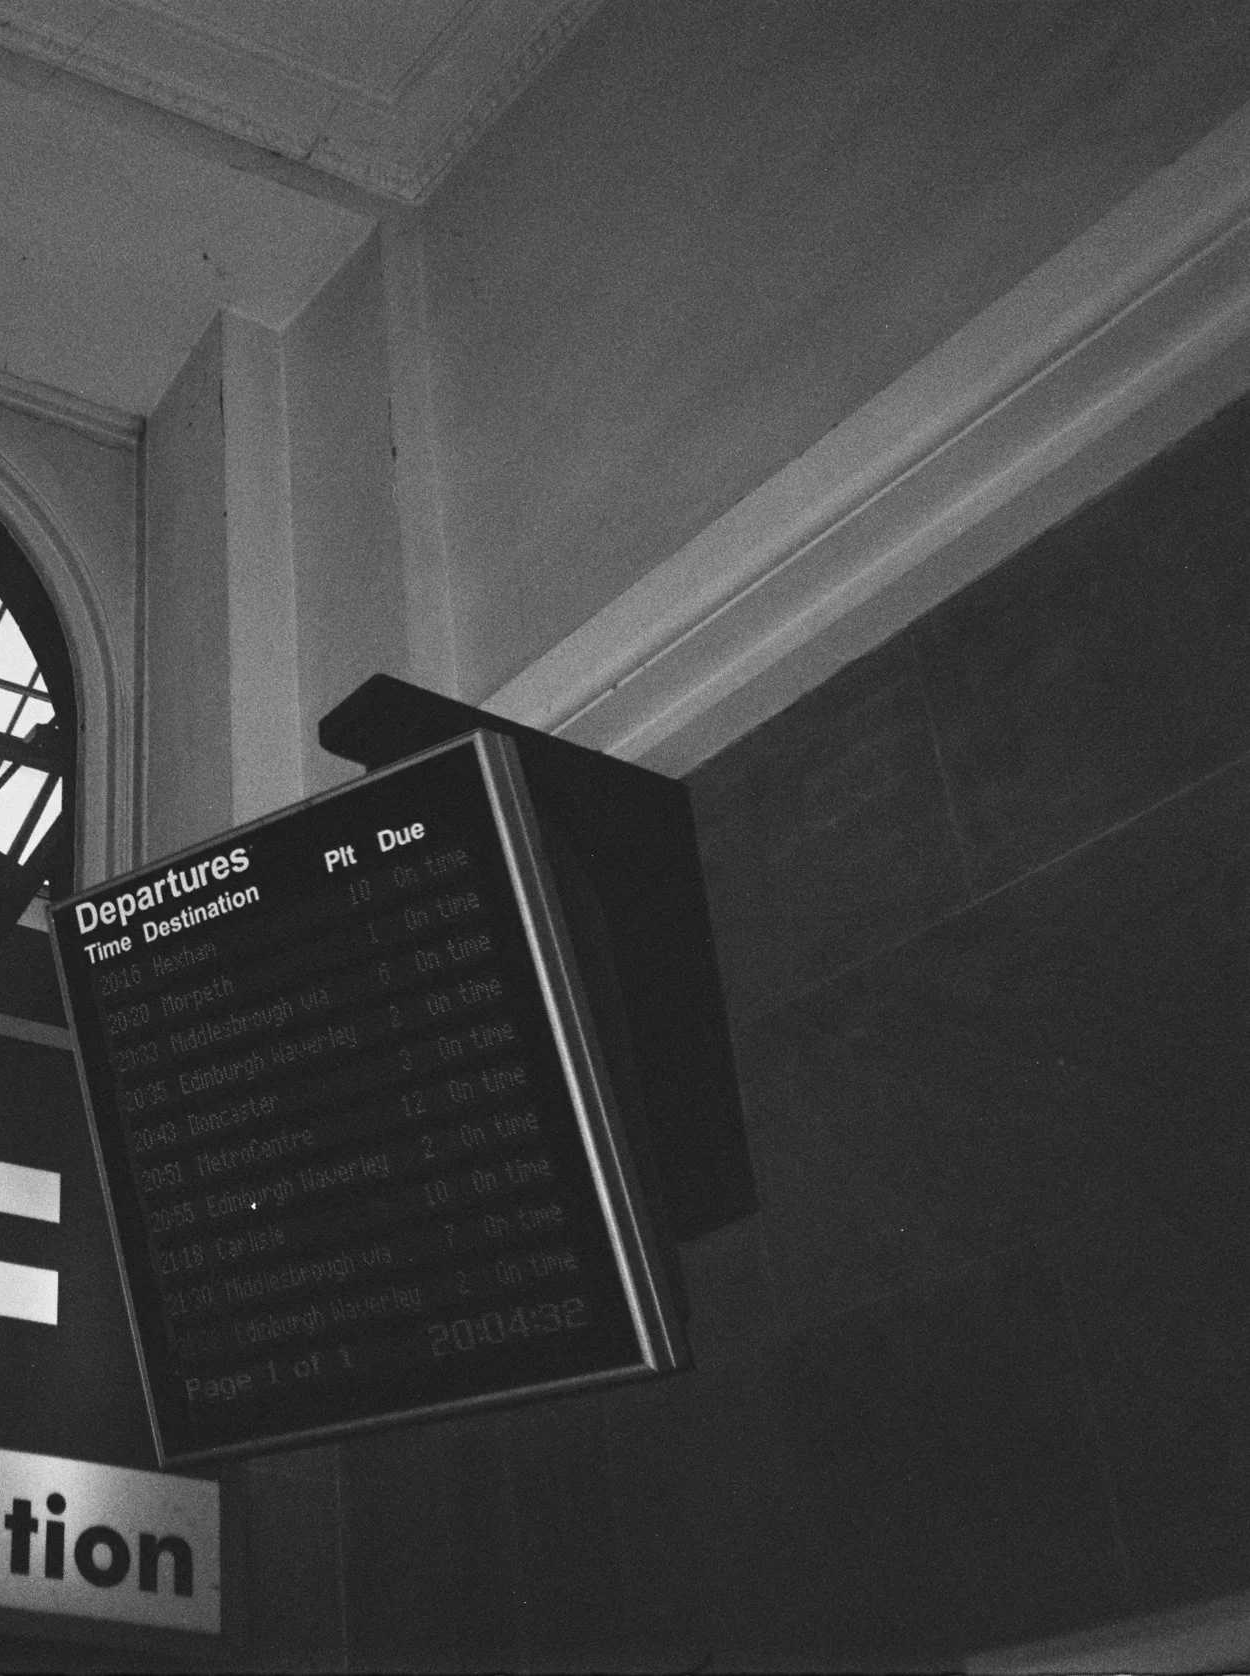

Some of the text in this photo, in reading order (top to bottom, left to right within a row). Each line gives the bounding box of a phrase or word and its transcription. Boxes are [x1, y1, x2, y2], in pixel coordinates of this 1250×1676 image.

[75, 847, 250, 935] Departures
[84, 822, 426, 964] Time Destination Plt Due
[100, 849, 468, 996] 20:16 Hexham 10 On time
[107, 892, 480, 1035] 20:20 Morpeth 1 On time
[170, 997, 293, 1053] Middlesbrough
[300, 987, 330, 1011] via
[414, 950, 440, 973] On
[447, 935, 491, 961] time
[178, 1051, 265, 1096] Edinburgh
[271, 1025, 357, 1065] Waverley
[388, 1004, 402, 1028] 2
[426, 993, 452, 1016] On
[458, 978, 502, 1004] time
[187, 1094, 279, 1136] Doncaster
[400, 1047, 412, 1071] 3
[438, 1036, 463, 1061] On
[470, 1023, 514, 1049] time
[141, 1067, 527, 1193] 20:51 MetroCentre 12 On time
[205, 1177, 294, 1218] Edinburgh
[299, 1153, 390, 1193] Waverley
[421, 1134, 435, 1159] 2
[460, 1124, 485, 1148] On
[494, 1111, 539, 1138] time
[216, 1225, 285, 1260] Carlisle
[423, 1180, 449, 1207] 10
[472, 1169, 497, 1194] On
[505, 1158, 551, 1184] time
[225, 1252, 355, 1300] Middlesbrough
[362, 1244, 393, 1267] via
[483, 1215, 509, 1238] On
[517, 1203, 563, 1231] time
[495, 1261, 522, 1285] On
[530, 1253, 579, 1278] time
[185, 1345, 354, 1401] Page 1 of 1
[428, 1297, 588, 1357] 20:04:32
